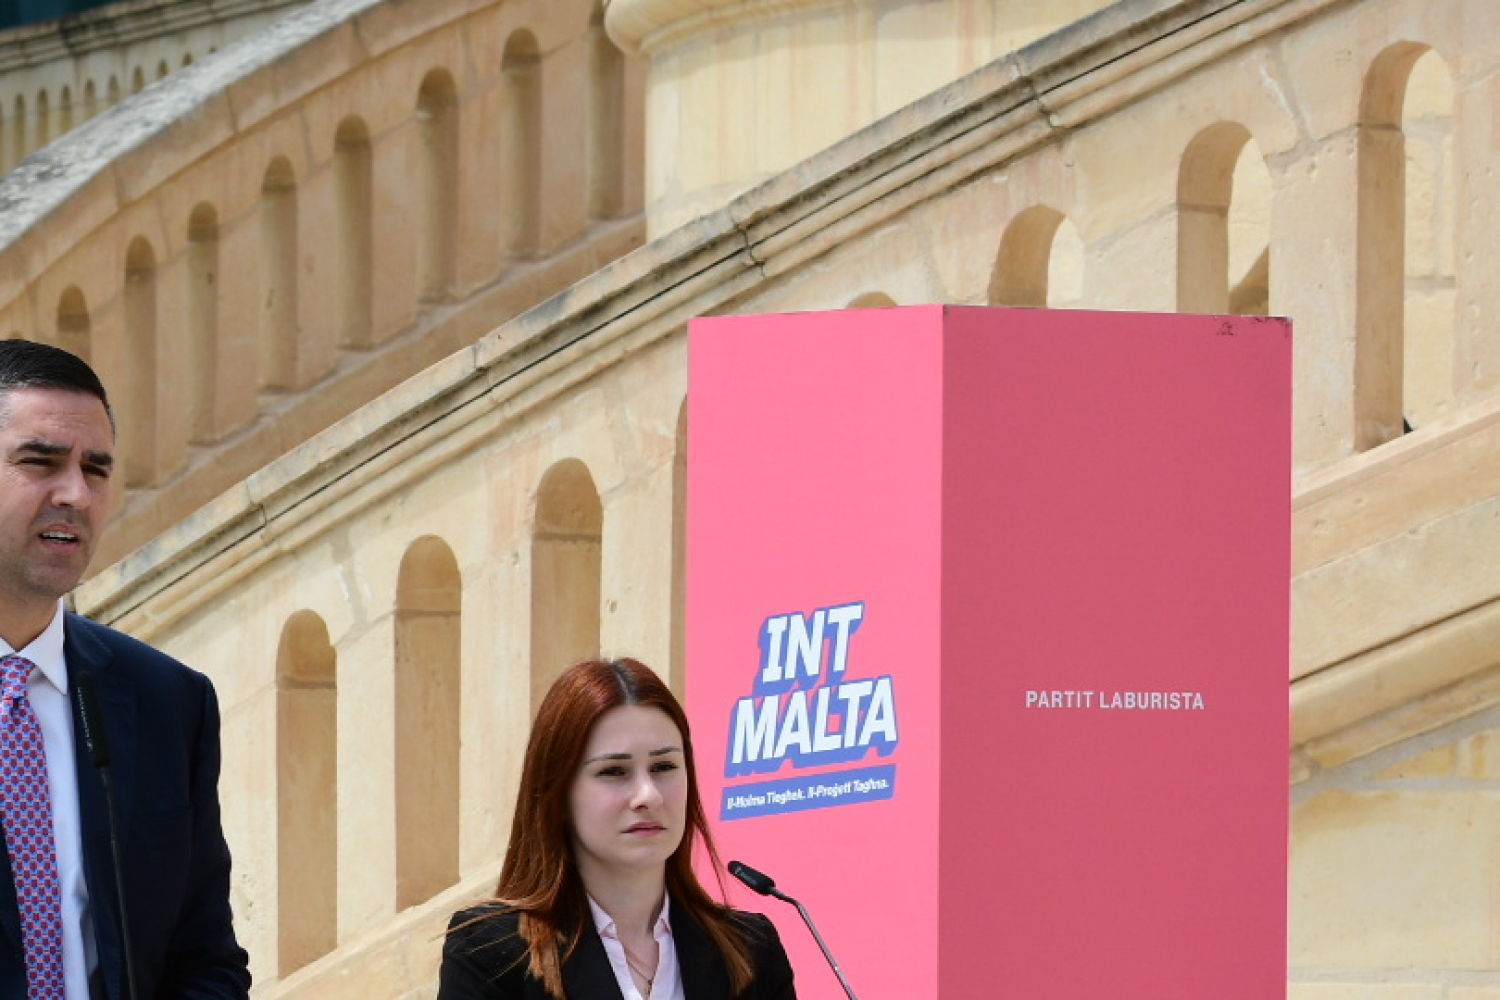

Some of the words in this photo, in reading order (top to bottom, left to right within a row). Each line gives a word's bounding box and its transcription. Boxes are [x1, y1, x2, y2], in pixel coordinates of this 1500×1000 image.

[762, 603, 863, 684] INT
[731, 677, 898, 764] MALTA
[1025, 690, 1094, 708] PARTIT
[1099, 691, 1205, 710] LABURISTA
